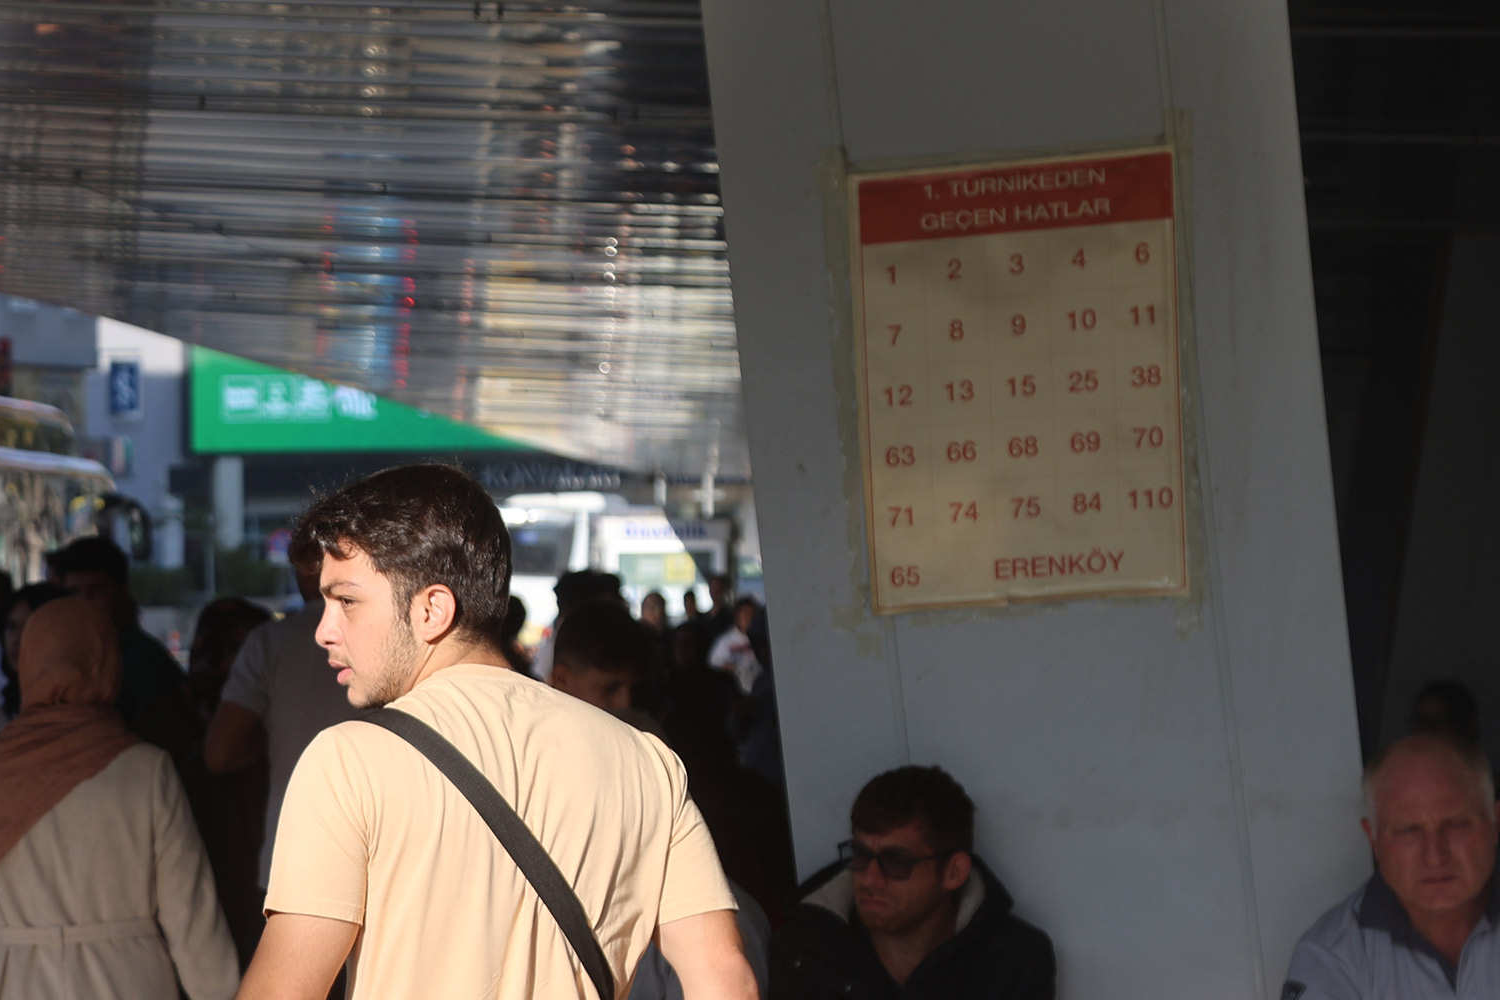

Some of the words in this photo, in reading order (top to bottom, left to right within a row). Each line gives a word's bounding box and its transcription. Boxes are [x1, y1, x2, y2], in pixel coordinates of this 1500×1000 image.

[923, 183, 940, 200] 1.
[921, 207, 1006, 232] GEÇEN
[1015, 198, 1111, 222] HATLAR
[886, 264, 897, 285] 1
[947, 259, 962, 281] 2
[1010, 253, 1024, 275] 3
[1071, 247, 1087, 268] 4
[1134, 242, 1150, 264] 6
[887, 325, 902, 346] 7
[949, 319, 964, 341] 8
[1011, 314, 1026, 336] 9
[1067, 309, 1097, 331] 10
[1130, 304, 1156, 326] 11
[885, 384, 913, 406] 12
[945, 380, 975, 402] 13
[1007, 375, 1037, 397] 15
[1068, 370, 1098, 393] 25
[1131, 365, 1161, 387] 38
[885, 445, 916, 467] 63
[946, 440, 977, 462] 66
[1008, 435, 1038, 458] 68
[1070, 431, 1101, 454] 69
[1133, 426, 1164, 449] 70
[887, 506, 915, 527] 71
[949, 501, 979, 523] 74
[1011, 496, 1041, 518] 75
[1073, 491, 1103, 514] 84
[1129, 486, 1174, 510] 110
[890, 565, 920, 587] 65
[994, 547, 1125, 581] ERENKÖY
